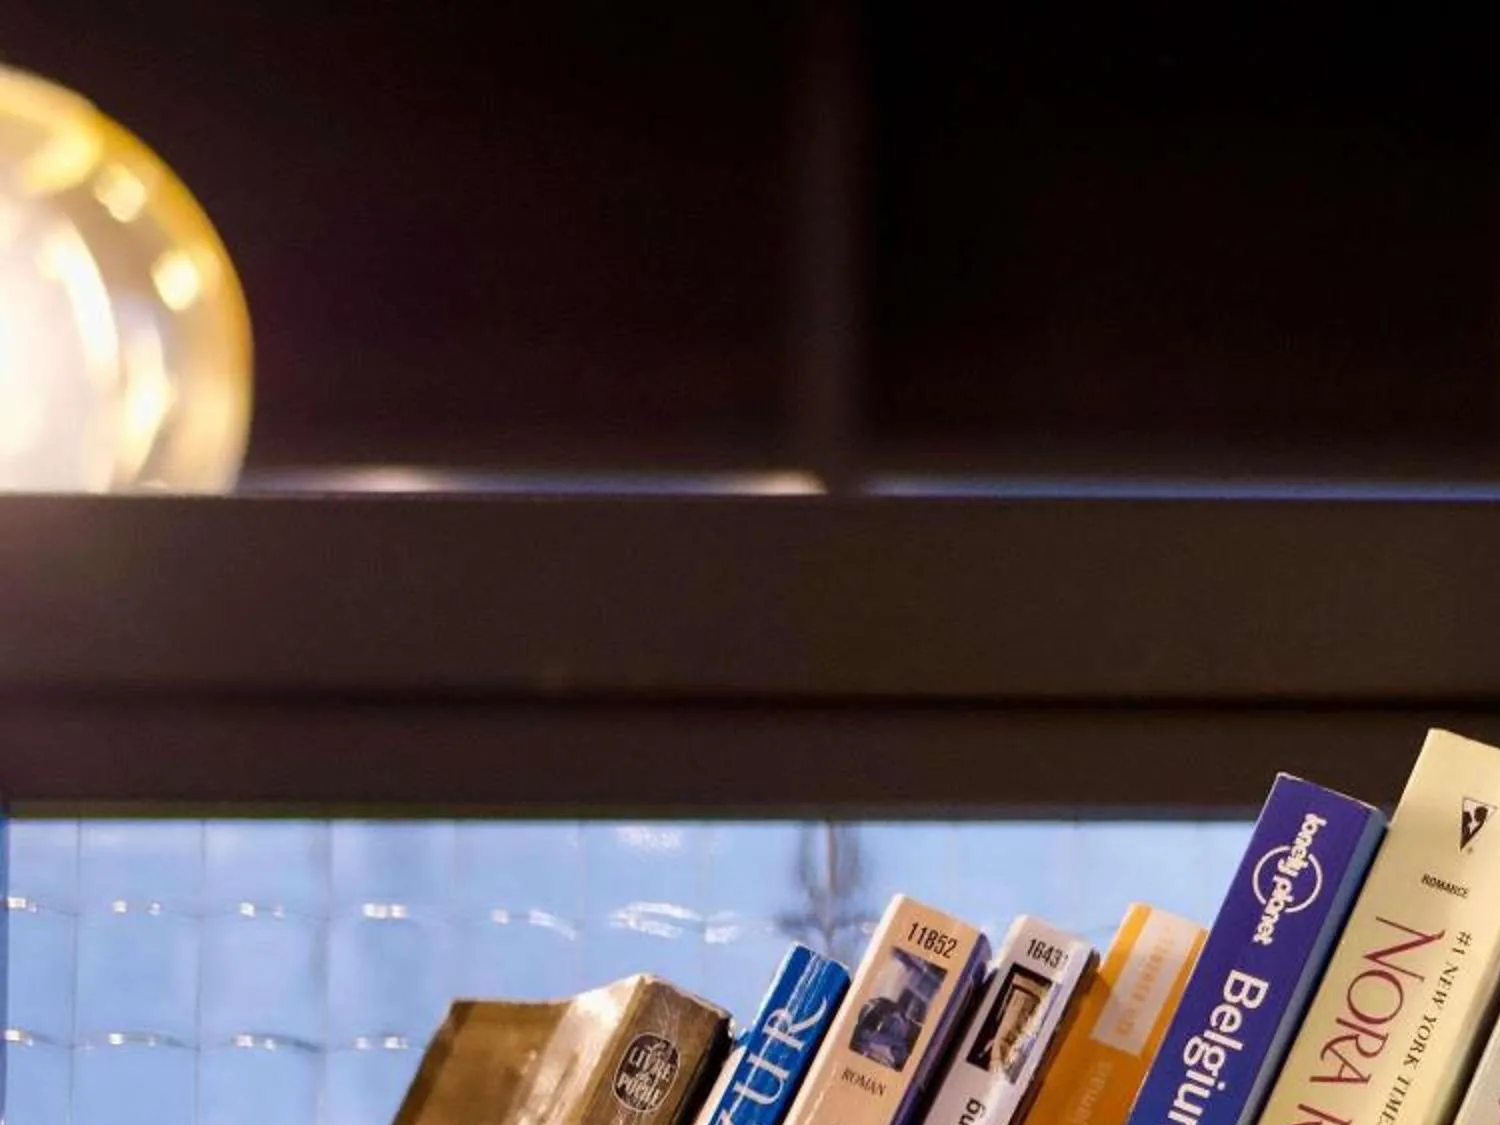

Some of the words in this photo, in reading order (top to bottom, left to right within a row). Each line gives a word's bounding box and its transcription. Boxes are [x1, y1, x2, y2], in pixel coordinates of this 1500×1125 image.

[1277, 812, 1327, 877] lonely
[1421, 873, 1470, 899] ROMANCE
[1253, 872, 1295, 947] planet
[906, 921, 957, 960] 11852
[1026, 938, 1069, 969] 1643
[1450, 930, 1473, 957] #1
[1309, 915, 1446, 1086] NORA
[1432, 961, 1459, 1009] NEW
[1403, 1015, 1438, 1069] YORK
[841, 1066, 886, 1097] ROMAN
